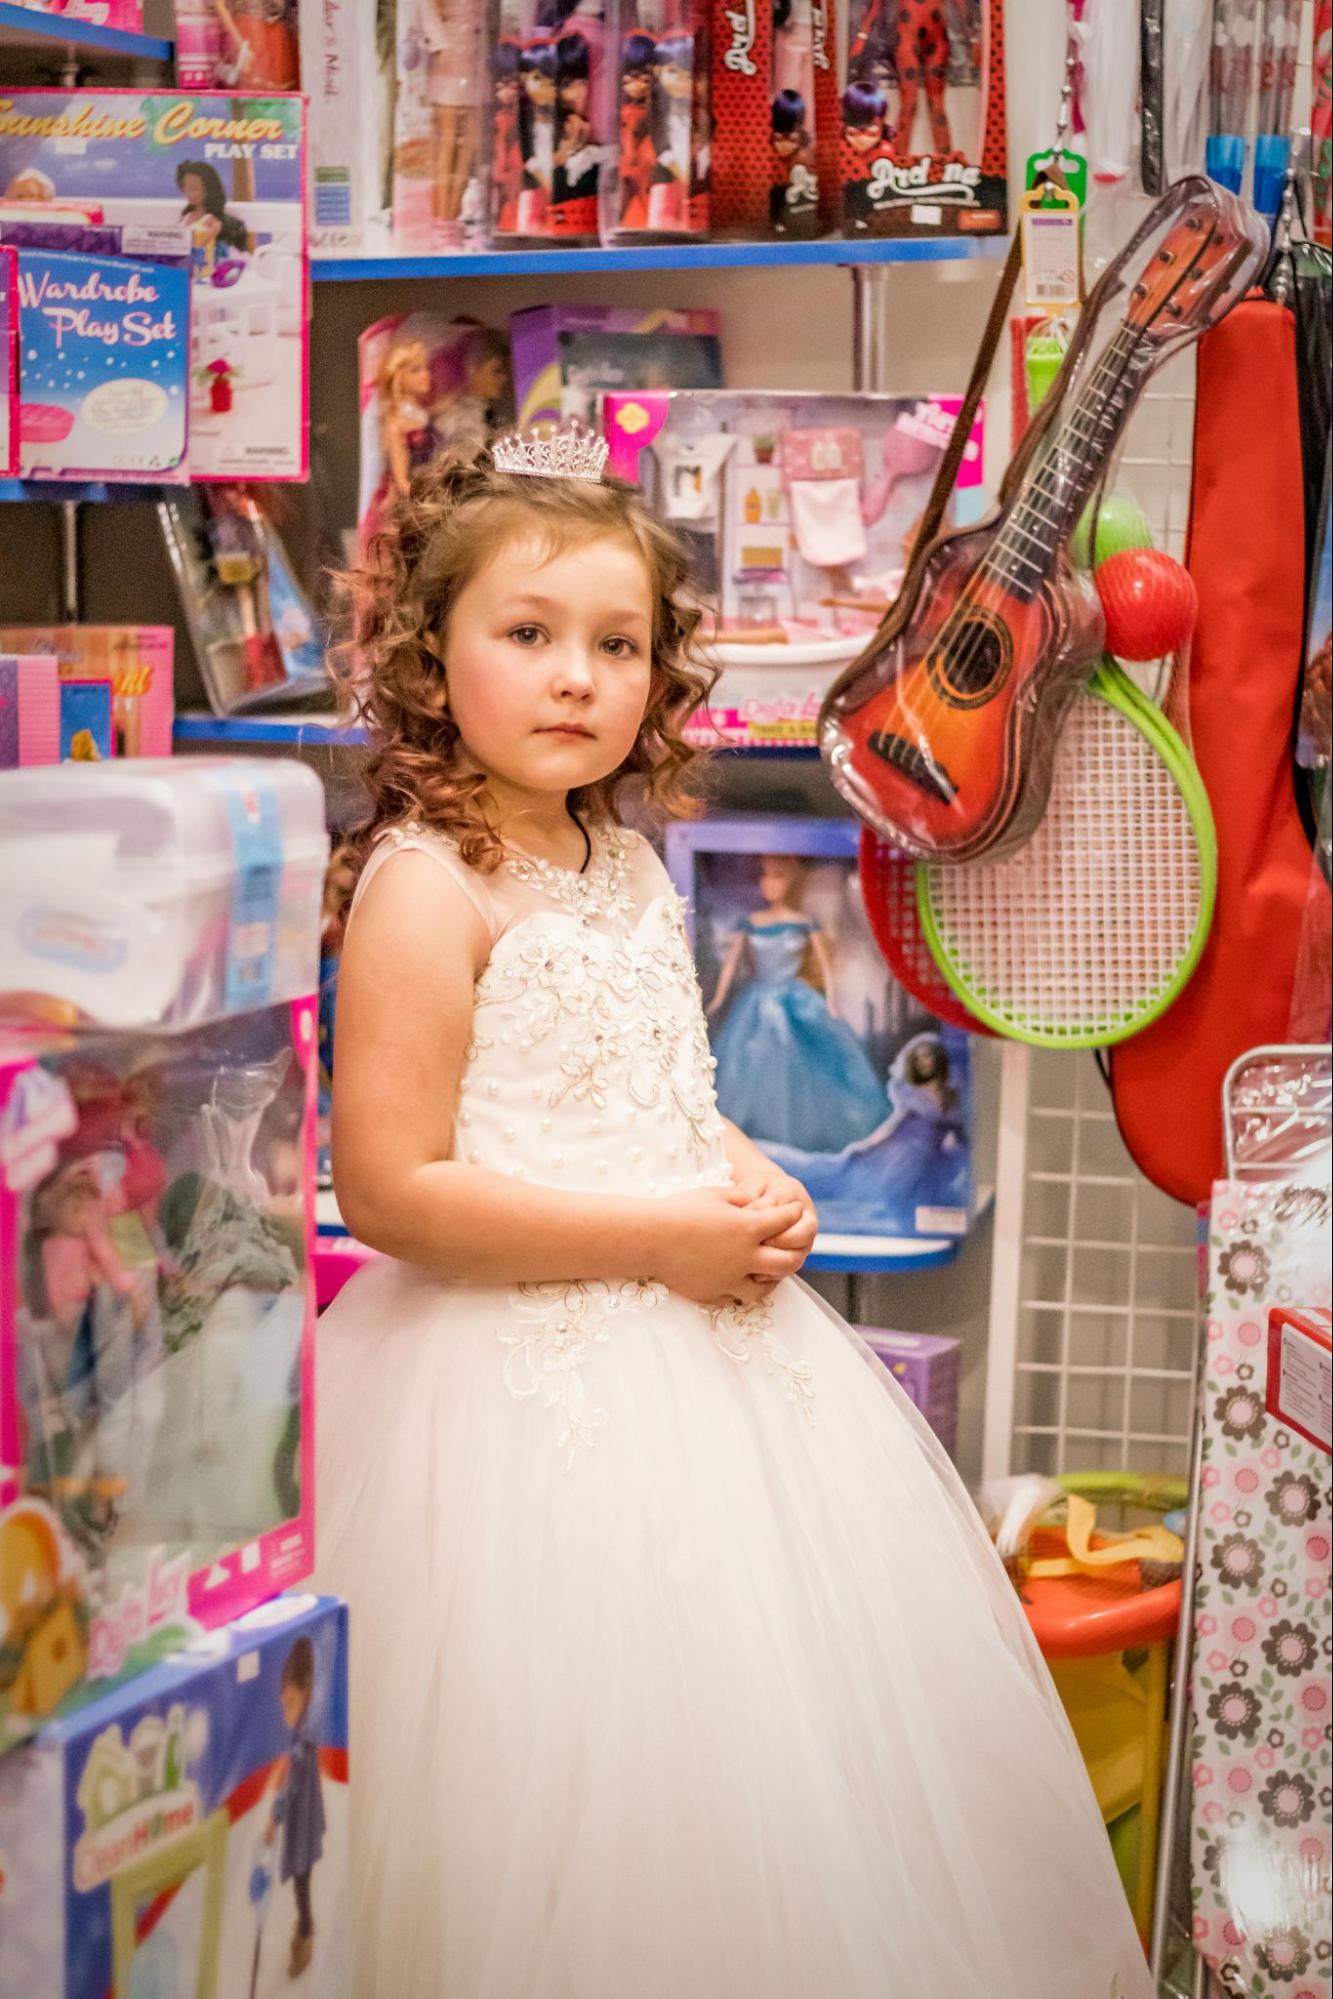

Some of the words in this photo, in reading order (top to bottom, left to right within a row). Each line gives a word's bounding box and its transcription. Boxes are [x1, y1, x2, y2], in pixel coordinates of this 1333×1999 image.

[153, 100, 284, 145] Corner
[204, 142, 254, 160] PLAY
[259, 142, 299, 160] SET
[17, 271, 161, 309] Wardrobe
[42, 307, 120, 349] Play
[122, 310, 177, 347] Set
